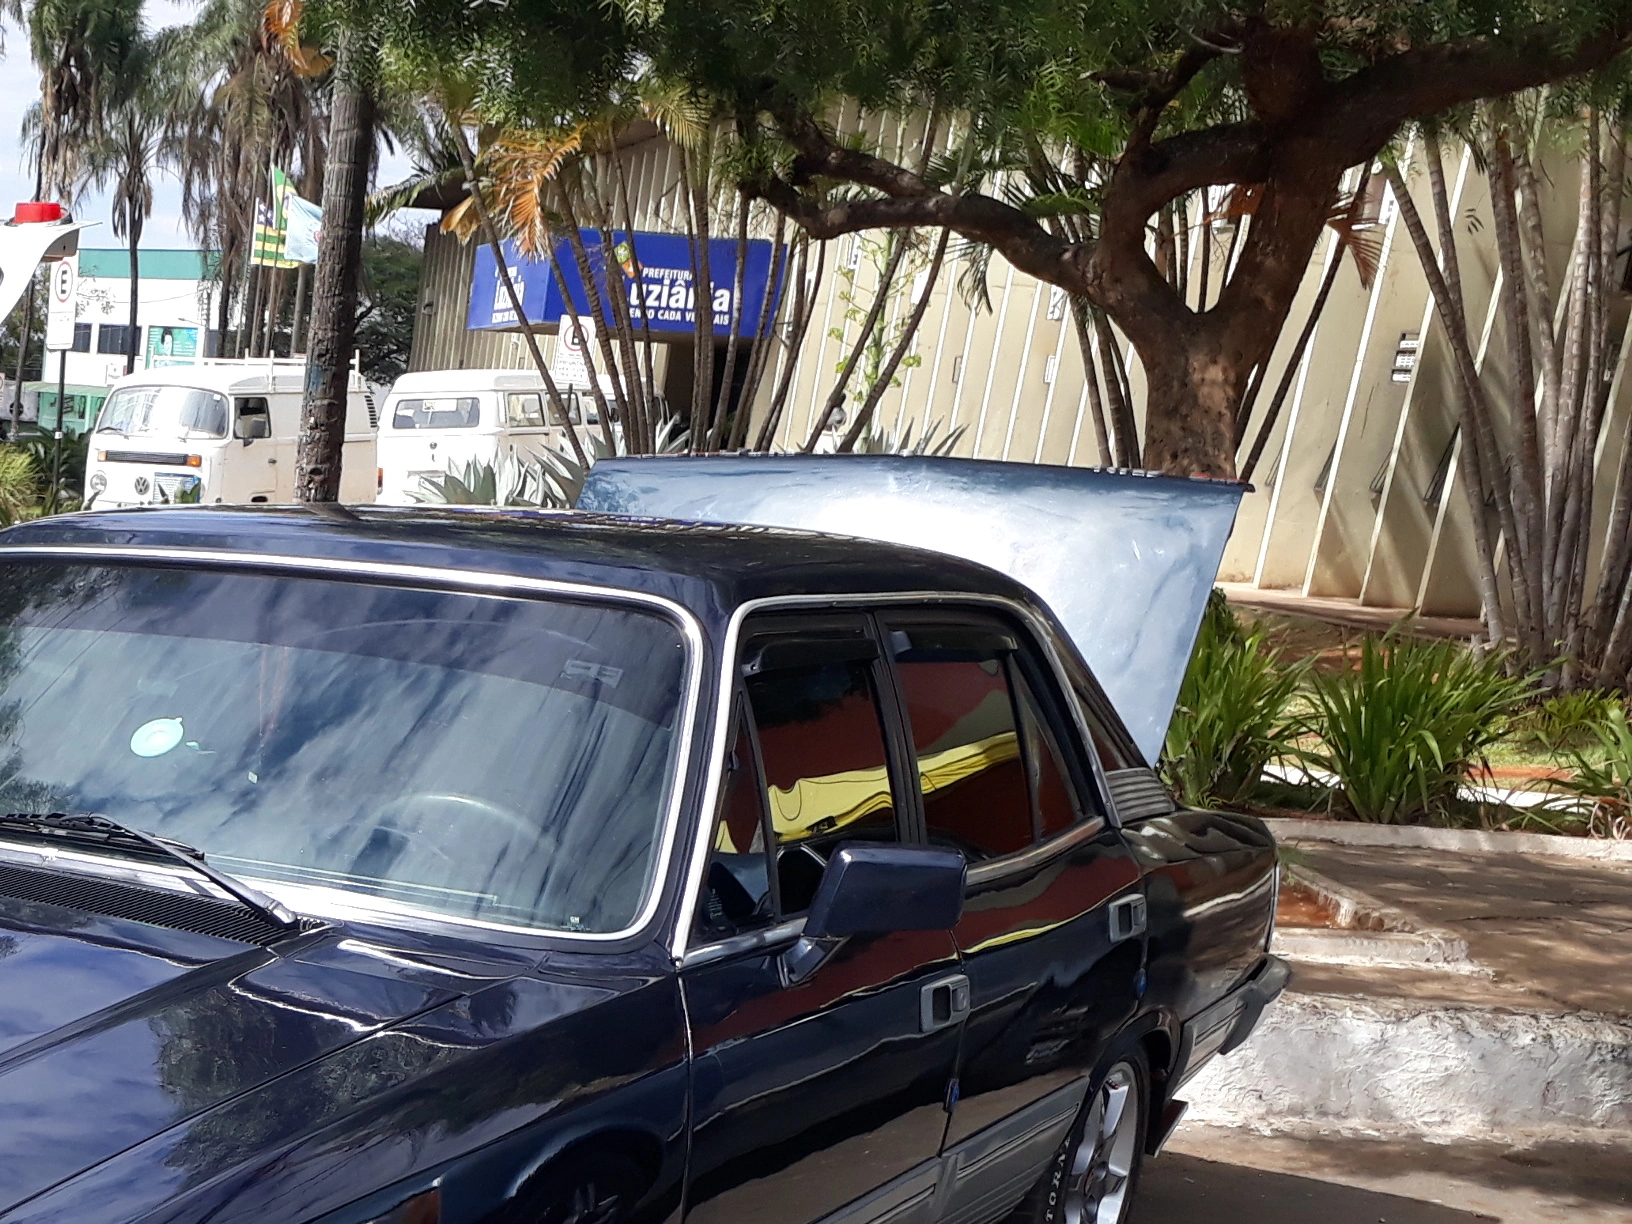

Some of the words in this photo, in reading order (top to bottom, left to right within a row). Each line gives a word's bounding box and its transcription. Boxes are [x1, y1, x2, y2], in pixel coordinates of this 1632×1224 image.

[60, 269, 68, 295] E
[657, 309, 681, 321] CADA
[712, 314, 730, 325] AIS
